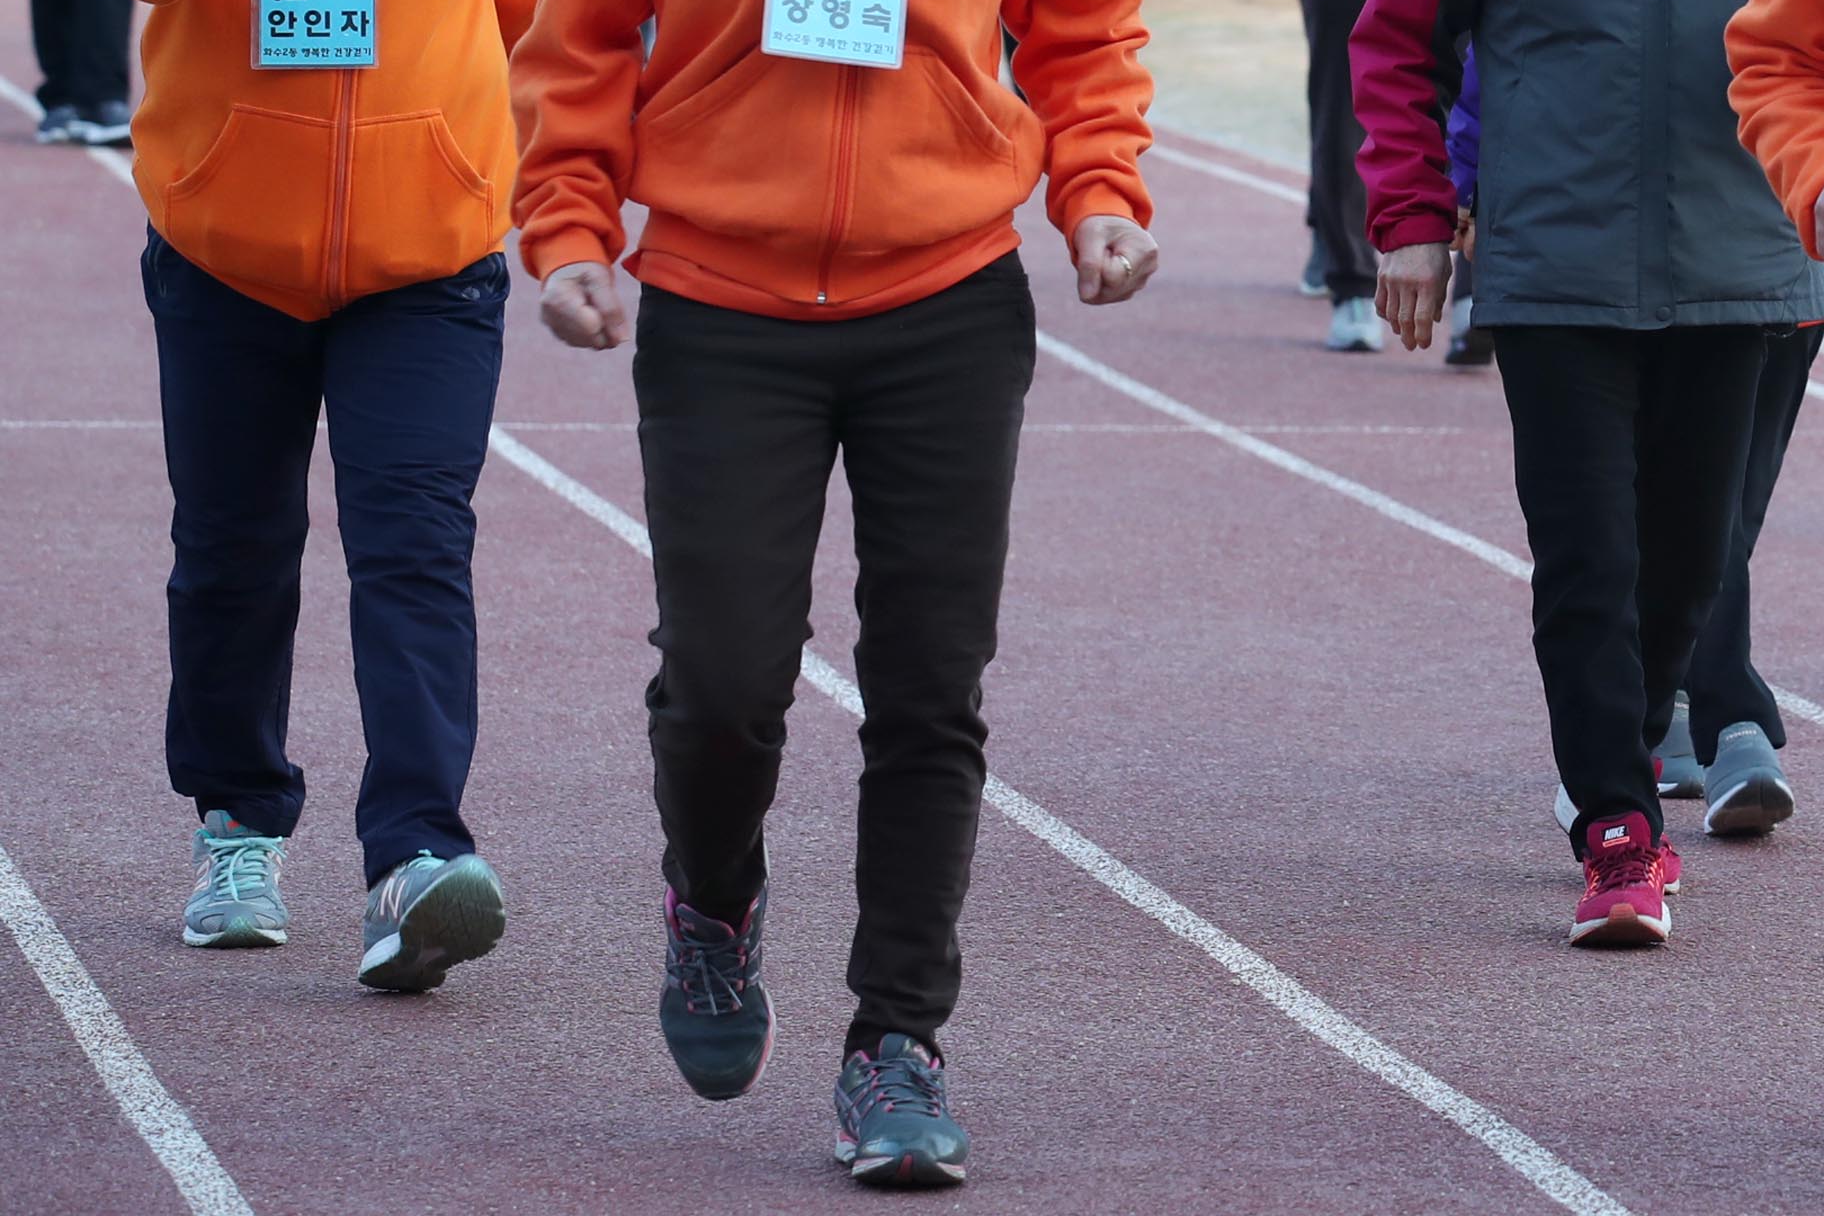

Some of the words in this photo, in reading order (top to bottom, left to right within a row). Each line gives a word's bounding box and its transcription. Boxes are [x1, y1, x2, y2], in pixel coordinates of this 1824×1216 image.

[267, 9, 370, 38] 안인자
[263, 47, 298, 58] 화수2동
[1604, 825, 1626, 841] NIKE
